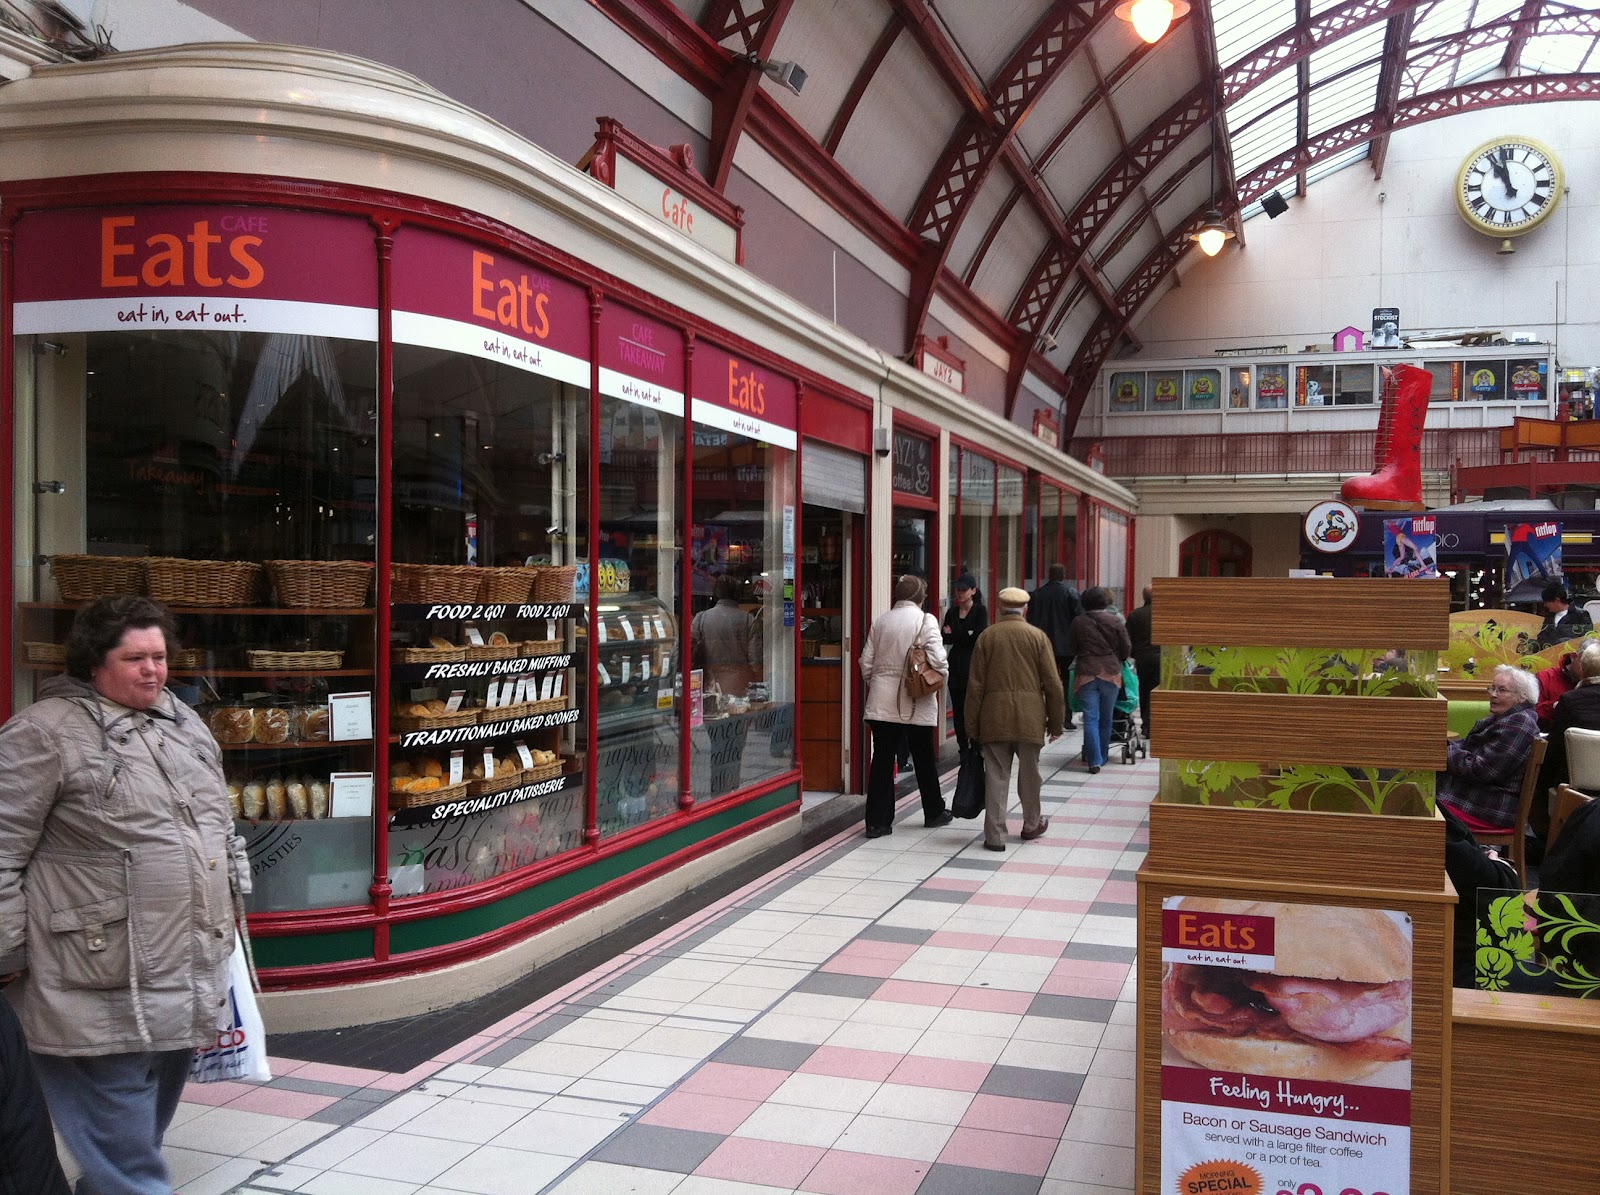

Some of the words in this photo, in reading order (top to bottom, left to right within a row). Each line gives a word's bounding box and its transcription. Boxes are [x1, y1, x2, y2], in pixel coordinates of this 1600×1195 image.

[662, 188, 693, 234] Cafe
[220, 216, 268, 233] CAFE
[101, 216, 265, 289] Eats
[472, 250, 550, 339] Eats
[117, 303, 147, 322] eat
[151, 306, 169, 324] in,
[175, 303, 209, 322] eat
[214, 304, 247, 323] out.
[632, 323, 655, 345] CAFE
[483, 337, 500, 355] eat
[513, 346, 528, 363] eat
[620, 342, 665, 375] TAKEAWAY
[728, 358, 765, 416] Eats
[893, 473, 912, 491] offee
[426, 604, 473, 619] FOOD
[472, 605, 483, 619] 2
[484, 604, 506, 621] GO!
[516, 604, 544, 618] FOOD
[543, 605, 551, 618] 2
[552, 604, 570, 619] GO!
[425, 661, 493, 679] FRESHLY
[492, 656, 529, 675] BAKED
[528, 654, 571, 671] MUFFINS
[403, 721, 512, 747] TRADITIONALLY
[511, 717, 544, 736] BAKED
[544, 709, 580, 728] SCONES
[431, 791, 511, 820] SPECIALITY
[509, 777, 566, 801] PATISSERIE
[251, 832, 303, 877] PASTIES
[1178, 914, 1256, 950] Eats
[1187, 953, 1203, 961] eat
[1216, 955, 1231, 964] eat
[1209, 1076, 1270, 1108] Feeling
[1276, 1080, 1360, 1117] Hungry...
[1183, 1111, 1227, 1129] Bacon
[1231, 1120, 1247, 1130] or
[1249, 1119, 1312, 1140] Sausage
[1315, 1126, 1387, 1146] Sandwich
[1204, 1132, 1240, 1145] served
[1242, 1136, 1265, 1148] with
[1267, 1141, 1274, 1149] a
[1276, 1139, 1303, 1153] large
[1305, 1142, 1328, 1154] filter
[1329, 1146, 1363, 1158] coffee
[1245, 1151, 1257, 1160] or
[1259, 1153, 1267, 1162] a
[1269, 1153, 1288, 1165] pot
[1289, 1155, 1301, 1165] of
[1303, 1156, 1322, 1168] tea.
[1188, 1176, 1253, 1194] SPECIAL
[1199, 1169, 1235, 1180] MORNING
[1277, 1179, 1297, 1189] only
